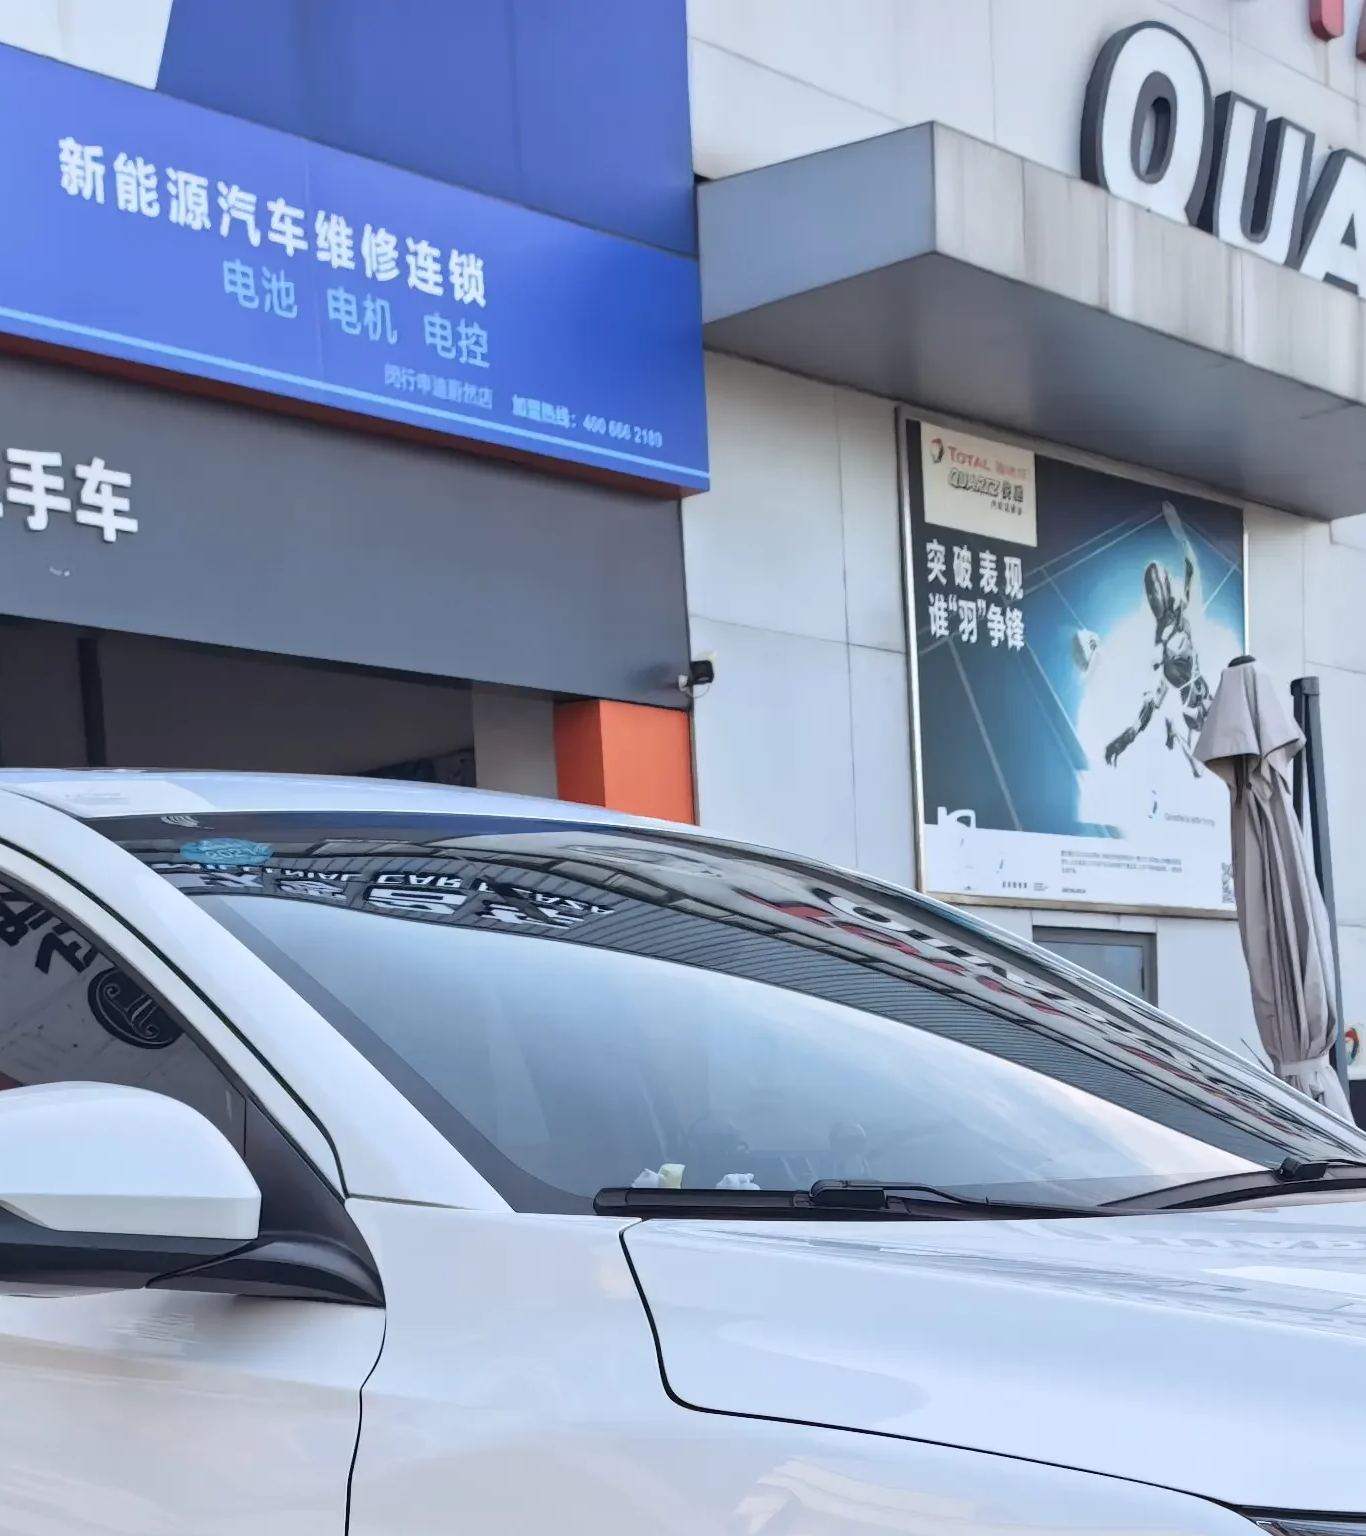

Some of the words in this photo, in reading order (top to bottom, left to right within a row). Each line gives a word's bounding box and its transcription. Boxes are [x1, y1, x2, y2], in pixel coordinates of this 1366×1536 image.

[58, 136, 487, 308] 新能源汽车维修连锁
[223, 258, 298, 320] 电池
[326, 288, 398, 346] 电机
[423, 312, 491, 369] 电控
[947, 444, 992, 471] TOTAL
[926, 539, 1023, 600] 突破表现
